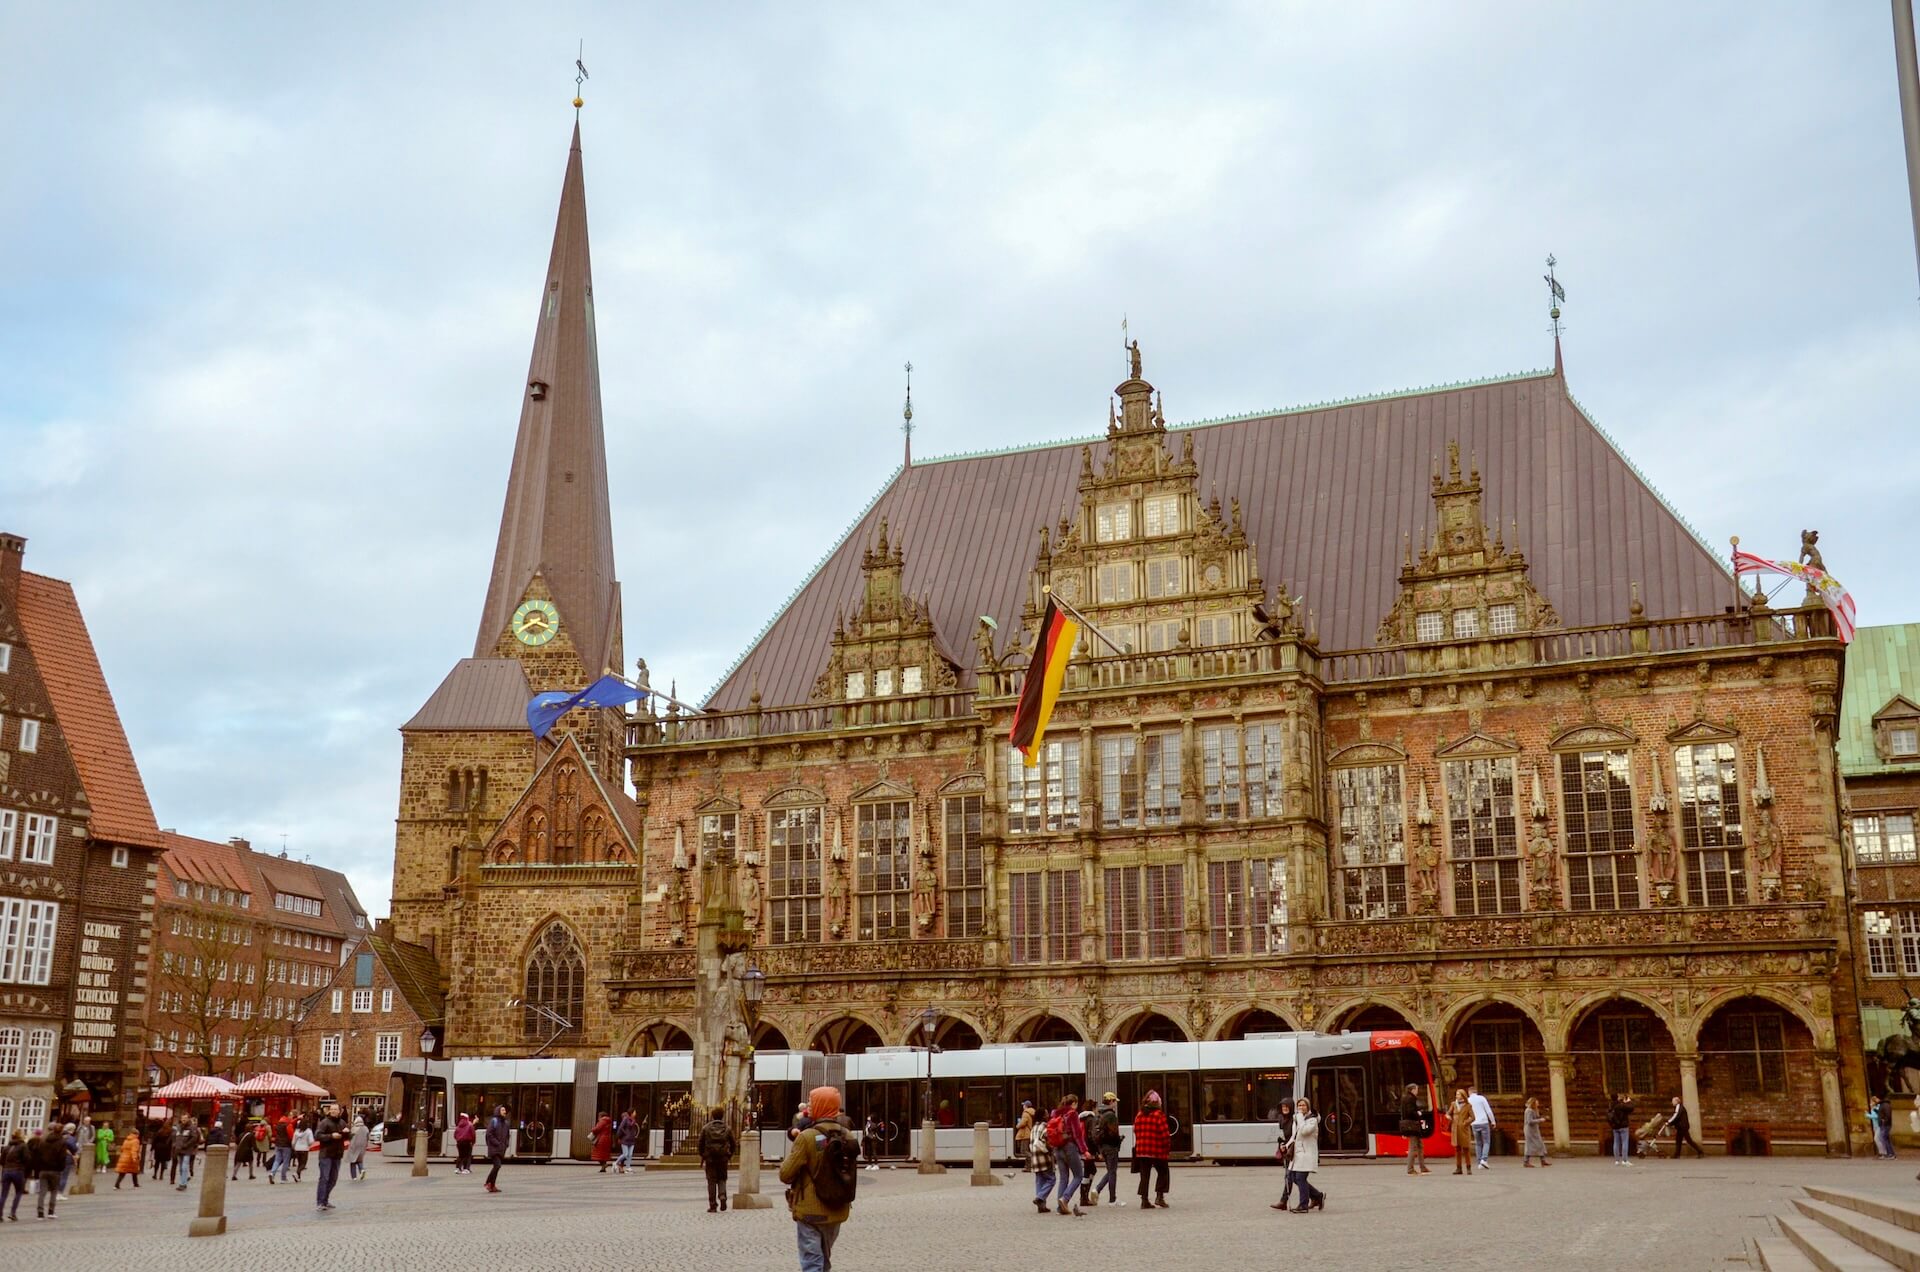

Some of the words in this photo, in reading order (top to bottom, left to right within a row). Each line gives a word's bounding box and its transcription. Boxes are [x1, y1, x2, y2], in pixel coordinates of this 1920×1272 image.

[84, 922, 120, 938] GEDENKE
[82, 938, 99, 953] DER
[80, 954, 117, 972] BRÜDER,
[78, 972, 93, 986] DIE
[93, 973, 110, 987] DAS
[76, 988, 119, 1004] SCHICKSAL
[74, 1005, 112, 1020] UNSERER
[73, 1022, 116, 1037] TRENNUNG
